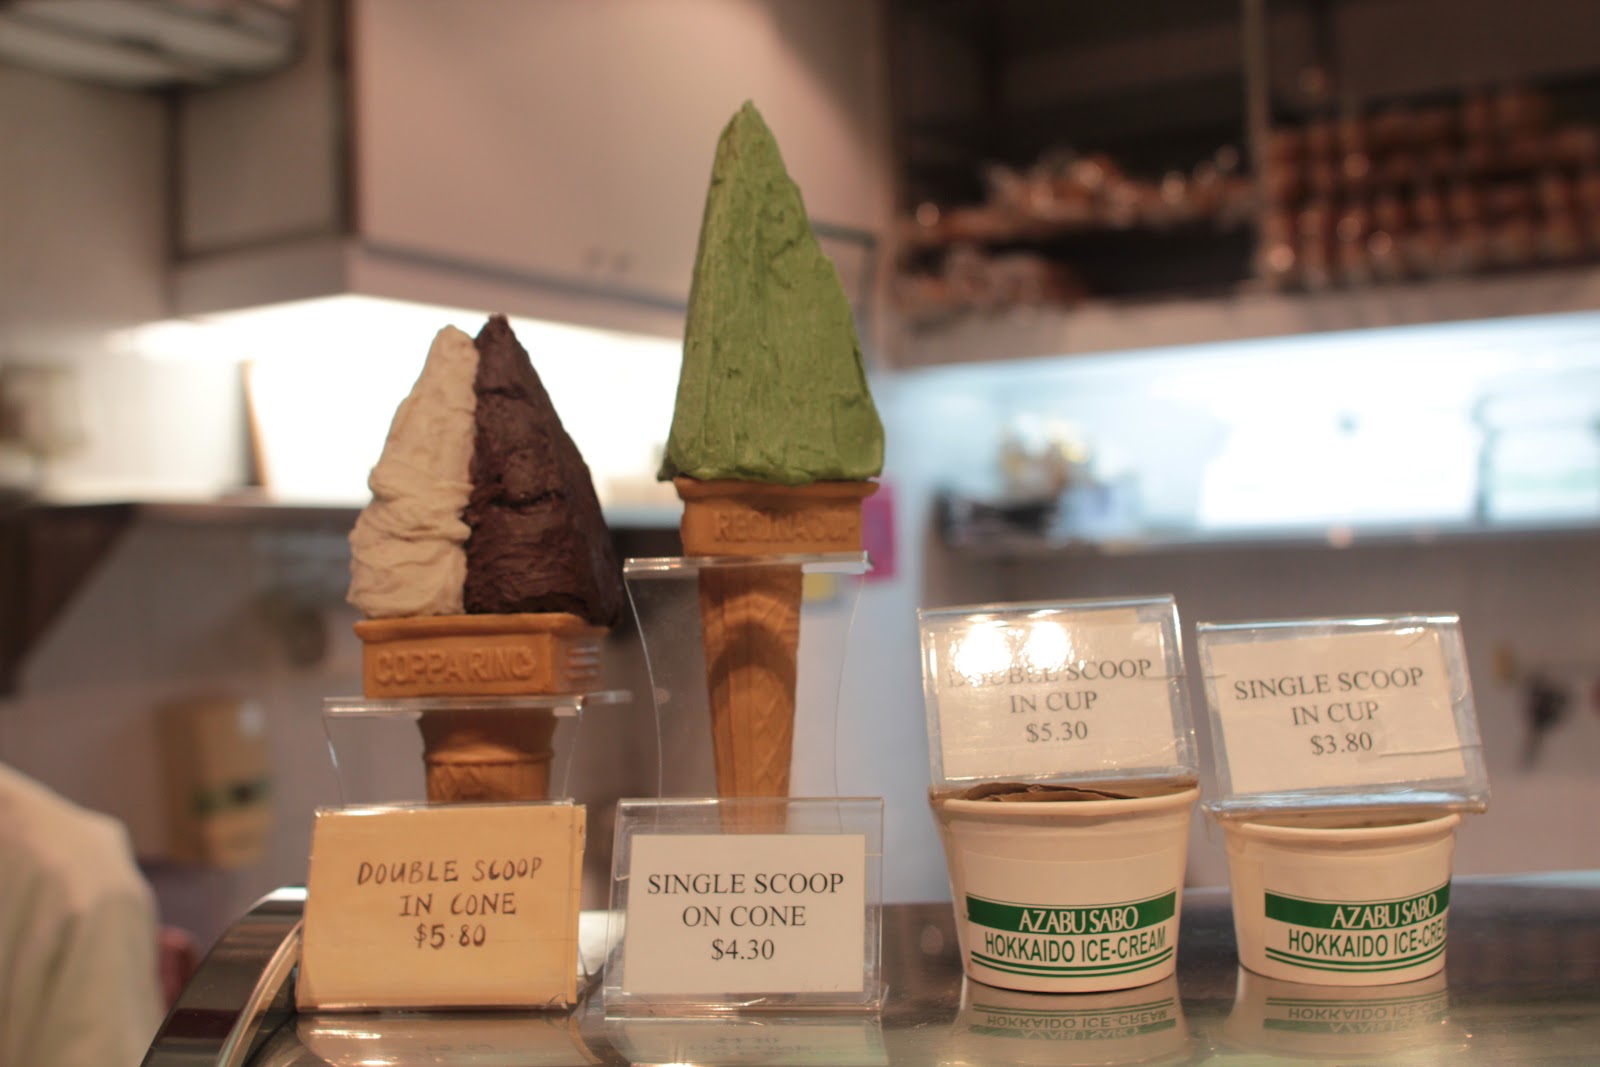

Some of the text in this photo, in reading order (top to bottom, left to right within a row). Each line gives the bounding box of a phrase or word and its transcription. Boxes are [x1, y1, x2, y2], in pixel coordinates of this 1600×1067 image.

[949, 659, 1151, 688] DUBLE SCOOP
[1234, 667, 1423, 700] SINGLE SCOOP
[1010, 691, 1098, 713] IN CUP
[1291, 701, 1379, 726] IN CUP
[1026, 721, 1088, 743] $5.30
[1311, 732, 1372, 755] $3.80
[357, 857, 543, 886] DOUBLE SCOOP
[647, 872, 844, 895] SINGLE SCOOP
[399, 892, 517, 917] IN CONE
[682, 905, 807, 928] ON CONE
[1331, 893, 1438, 930] AZABU SABO
[1018, 906, 1139, 934] AZABU SABO
[414, 923, 487, 949] $5.80
[985, 926, 1166, 963] HOKKAIDO ICE-CREAM
[1288, 928, 1388, 957] HOKKAIDO
[711, 937, 775, 962] $4.30
